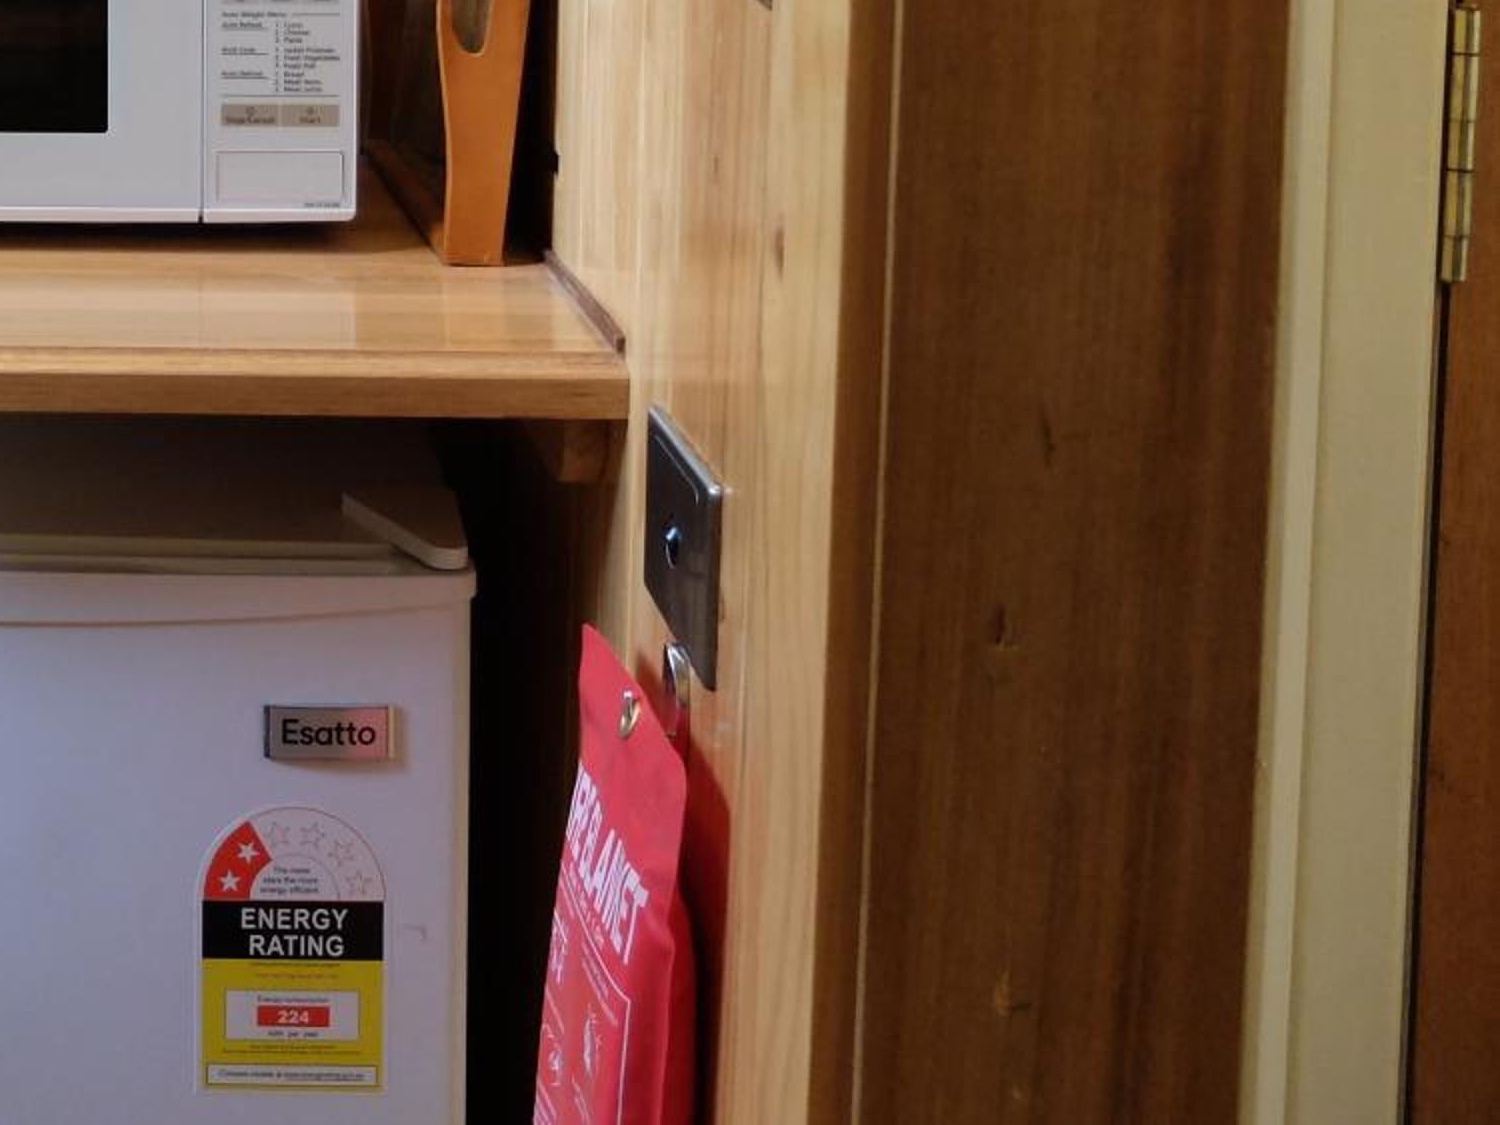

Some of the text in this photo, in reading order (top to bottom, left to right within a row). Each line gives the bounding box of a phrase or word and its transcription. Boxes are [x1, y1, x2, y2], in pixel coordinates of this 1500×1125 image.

[282, 719, 376, 746] Esatto
[241, 908, 348, 930] ENERGY
[249, 934, 344, 957] RATING
[277, 1009, 309, 1024] 224
